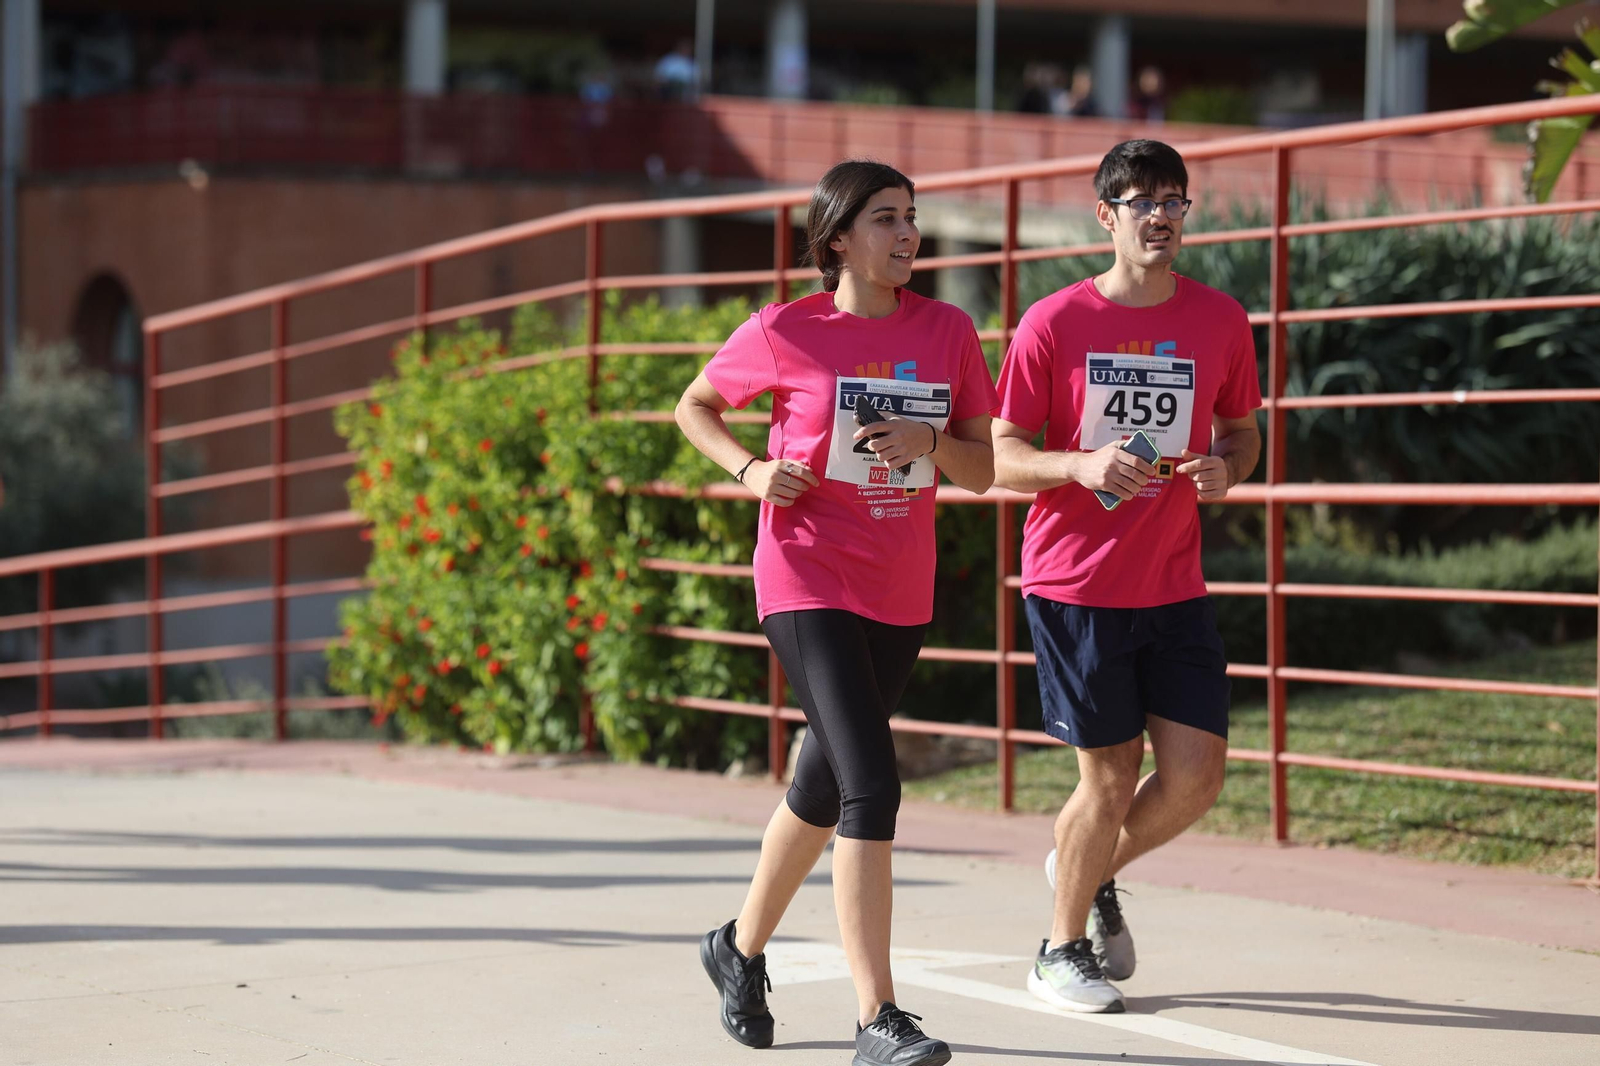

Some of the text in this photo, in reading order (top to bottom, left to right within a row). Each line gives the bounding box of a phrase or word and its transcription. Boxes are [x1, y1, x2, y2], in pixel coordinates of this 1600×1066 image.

[1092, 370, 1140, 384] UMA
[1104, 390, 1178, 427] 459
[870, 470, 888, 480] WE
